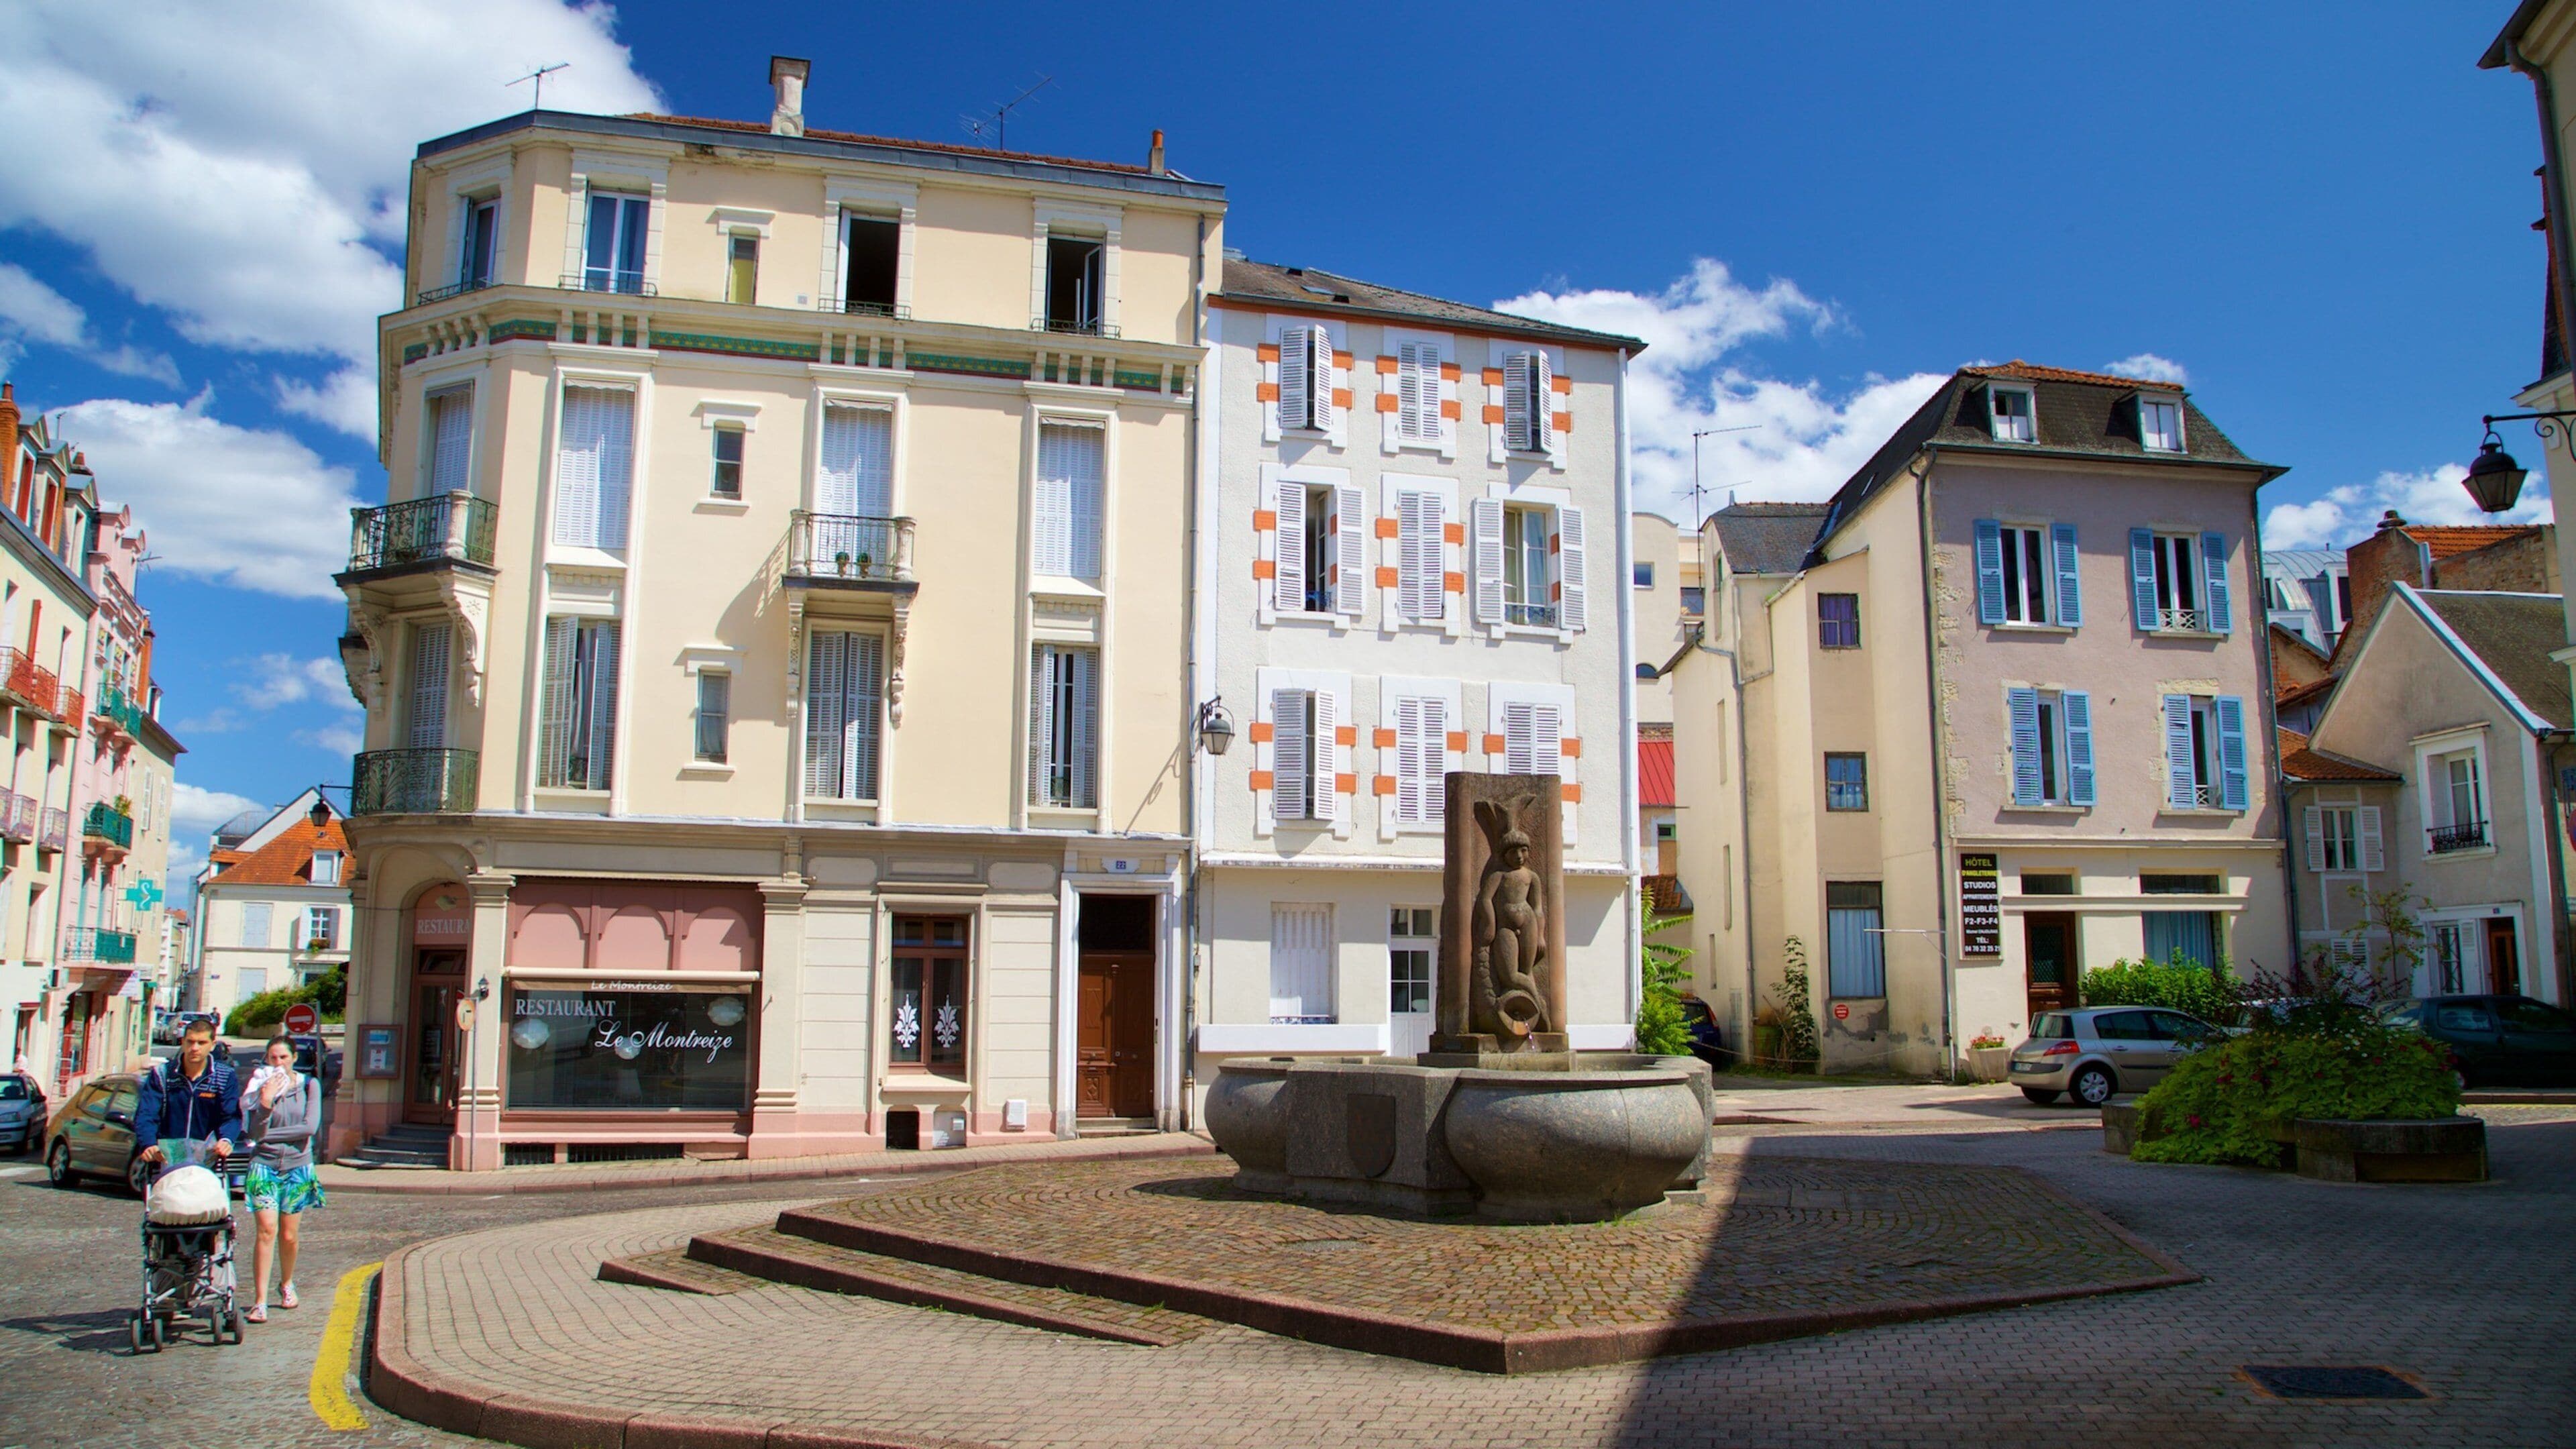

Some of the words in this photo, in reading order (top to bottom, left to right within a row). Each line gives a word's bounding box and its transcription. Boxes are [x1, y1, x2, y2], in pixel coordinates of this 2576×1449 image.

[1965, 856, 1992, 867] HÔTEL
[1963, 904, 1998, 912] MEUBLÉS
[1964, 917, 1998, 925] F2-F3-F4
[591, 980, 606, 989] Le
[608, 980, 674, 991] Montreize
[515, 998, 616, 1017] RESTAURANT
[594, 1020, 623, 1048] Le
[630, 1021, 733, 1064] Montreize
